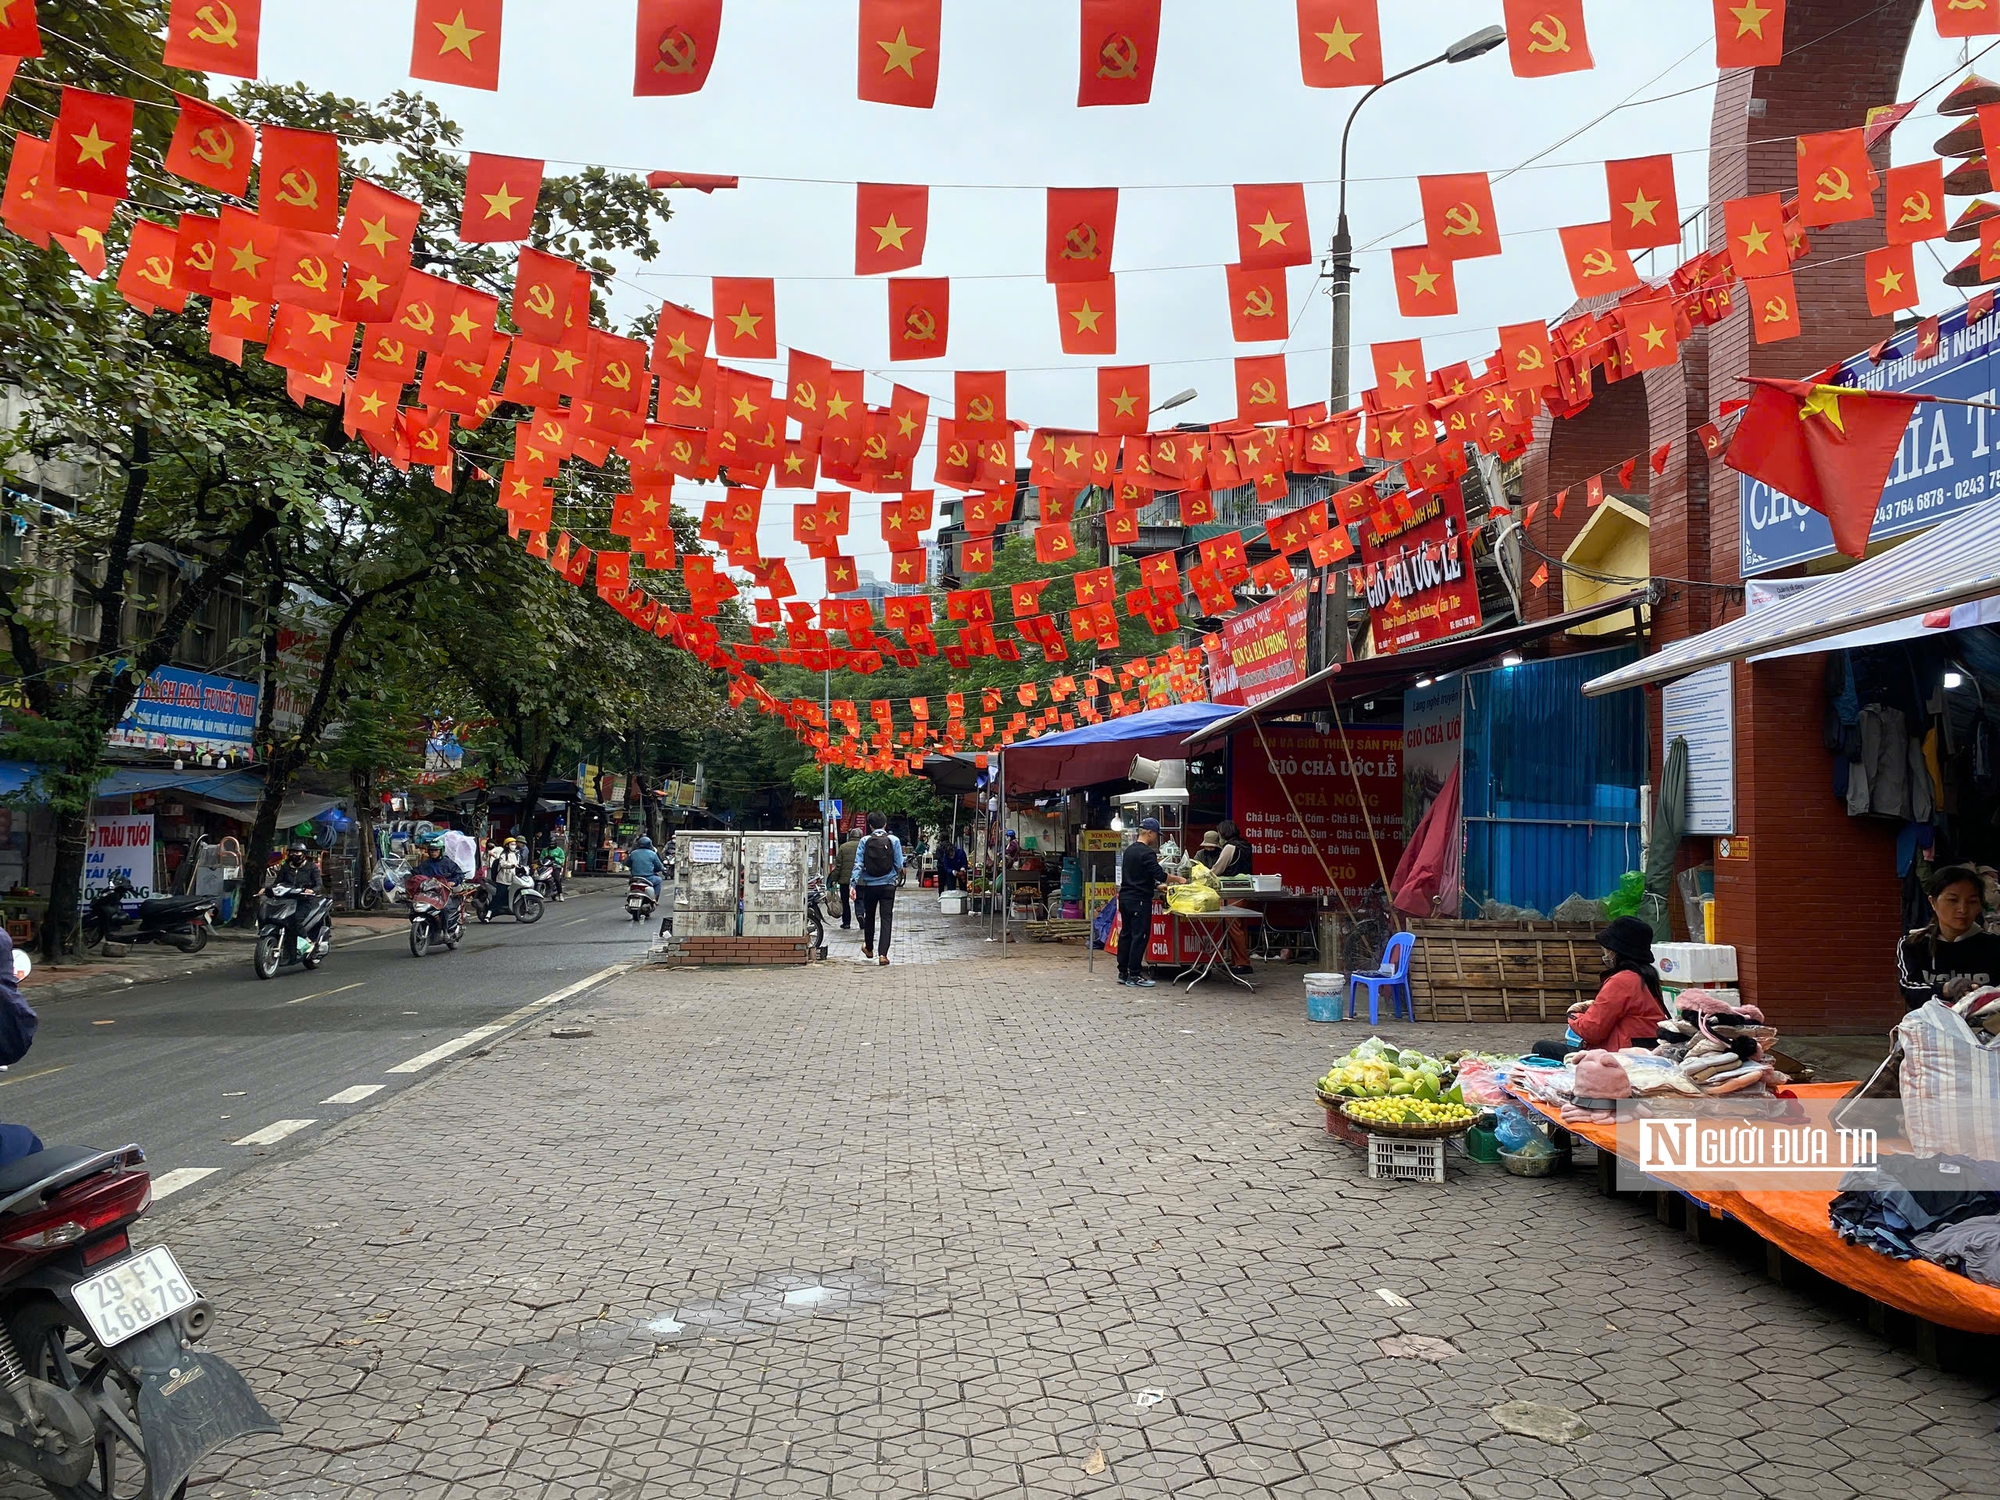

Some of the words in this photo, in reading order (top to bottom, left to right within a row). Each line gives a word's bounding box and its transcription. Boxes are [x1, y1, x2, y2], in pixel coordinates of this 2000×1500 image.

[1967, 387, 2000, 459] T
[1873, 505, 1893, 525] 243
[1895, 497, 1914, 517] 764
[1917, 487, 1944, 511] 6878
[1955, 474, 1985, 500] 0243
[1265, 628, 1288, 657] PHÒNG
[176, 680, 201, 709] HOÁ
[203, 682, 236, 714] TUYẾT
[1407, 723, 1422, 748] GIÒ
[1424, 715, 1444, 745] CHẢ
[1446, 713, 1461, 741] ƯỚ
[1253, 736, 1276, 748] BN
[1357, 736, 1380, 750] SẢN
[1268, 755, 1297, 775] GIÒ
[1302, 754, 1336, 776] CHẢ
[1378, 754, 1397, 777] LỄ
[1295, 787, 1328, 807] CHẢ
[1246, 812, 1263, 822] Chả
[1265, 813, 1280, 824] Lụa
[1331, 813, 1347, 824] Chả
[1368, 814, 1381, 824] hả
[98, 820, 125, 847] TRÂU
[126, 822, 151, 847] TƯƠI
[1246, 827, 1262, 838] Chả
[1265, 829, 1283, 840] Mực
[1336, 828, 1353, 840] Chả
[1252, 843, 1262, 853] hả
[1265, 843, 1276, 854] Cá
[1282, 844, 1299, 854] Chả
[1328, 845, 1340, 855] Bò
[1341, 844, 1360, 855] Viên
[1329, 864, 1356, 880] GIÒ
[1102, 886, 1116, 896] NƯỚ
[1152, 939, 1169, 955] CHẢ
[90, 1256, 163, 1309] 29-F1
[100, 1278, 188, 1338] 468.76
